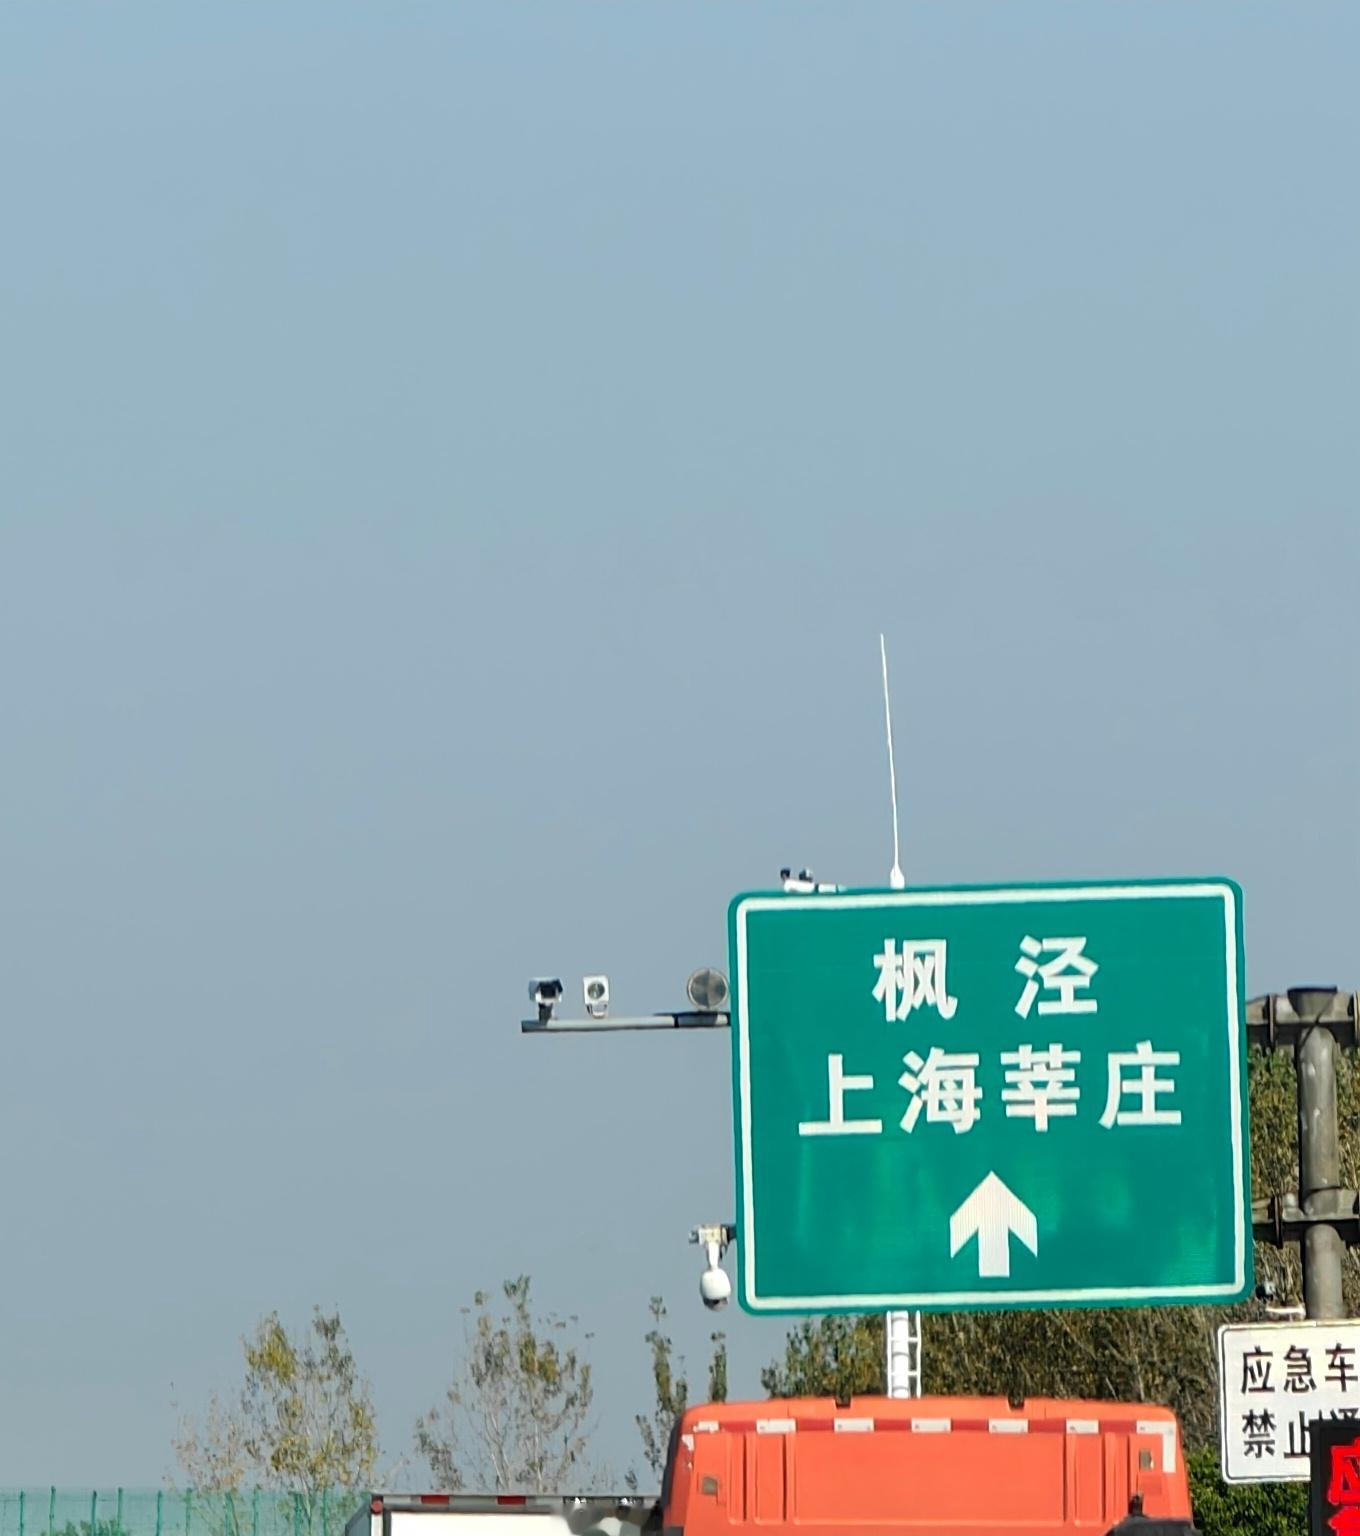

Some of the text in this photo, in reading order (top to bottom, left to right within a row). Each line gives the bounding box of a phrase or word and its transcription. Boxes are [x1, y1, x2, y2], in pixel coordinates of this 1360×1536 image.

[872, 935, 1099, 1021] 枫泾
[798, 1041, 1182, 1136] 上海莘庄
[1242, 1407, 1360, 1459] 禁止
